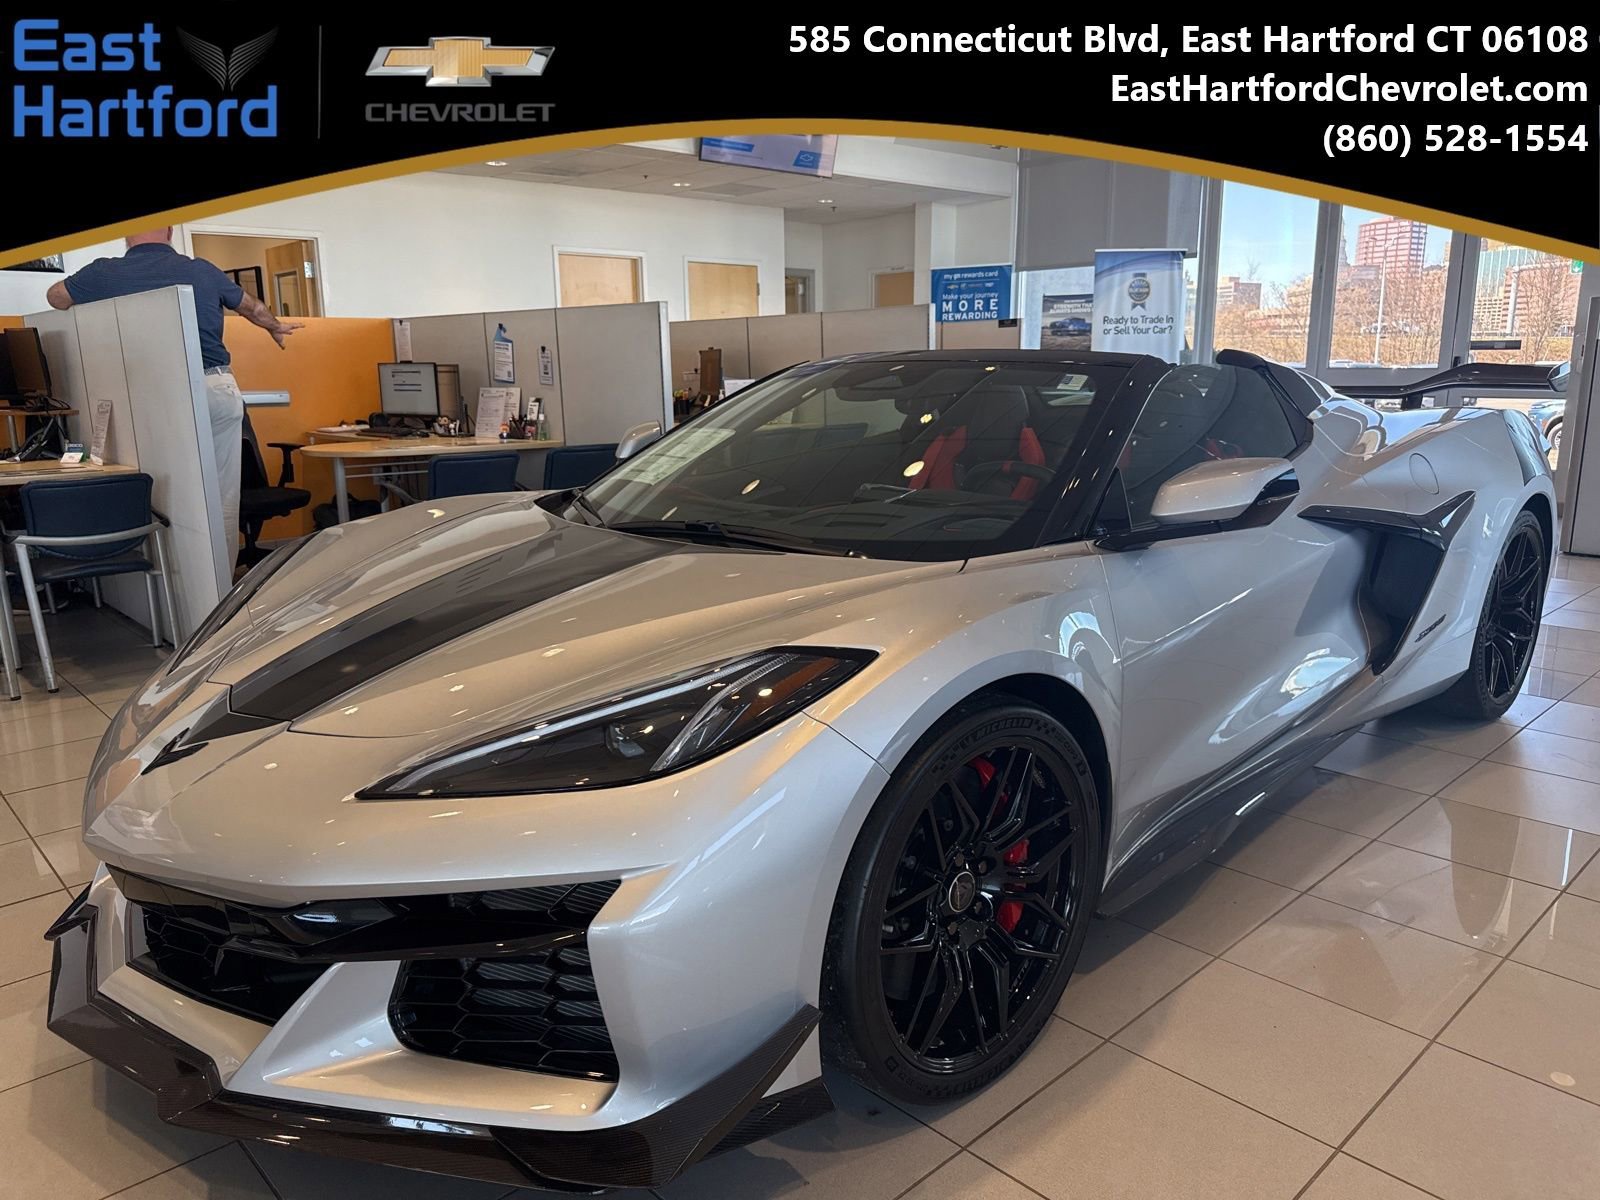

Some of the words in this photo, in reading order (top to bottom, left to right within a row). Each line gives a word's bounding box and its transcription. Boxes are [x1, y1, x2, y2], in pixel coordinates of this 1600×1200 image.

[962, 271, 984, 279] rewards
[942, 298, 999, 313] MORE
[942, 311, 998, 321] REWARDING
[1103, 315, 1129, 326] Ready
[1130, 316, 1139, 324] to
[1140, 315, 1164, 324] Trade
[1165, 315, 1174, 324] In
[1113, 326, 1130, 335] Sell
[1131, 326, 1151, 335] Your
[1152, 325, 1173, 335] Car?
[976, 717, 1034, 740] MICHELIN
